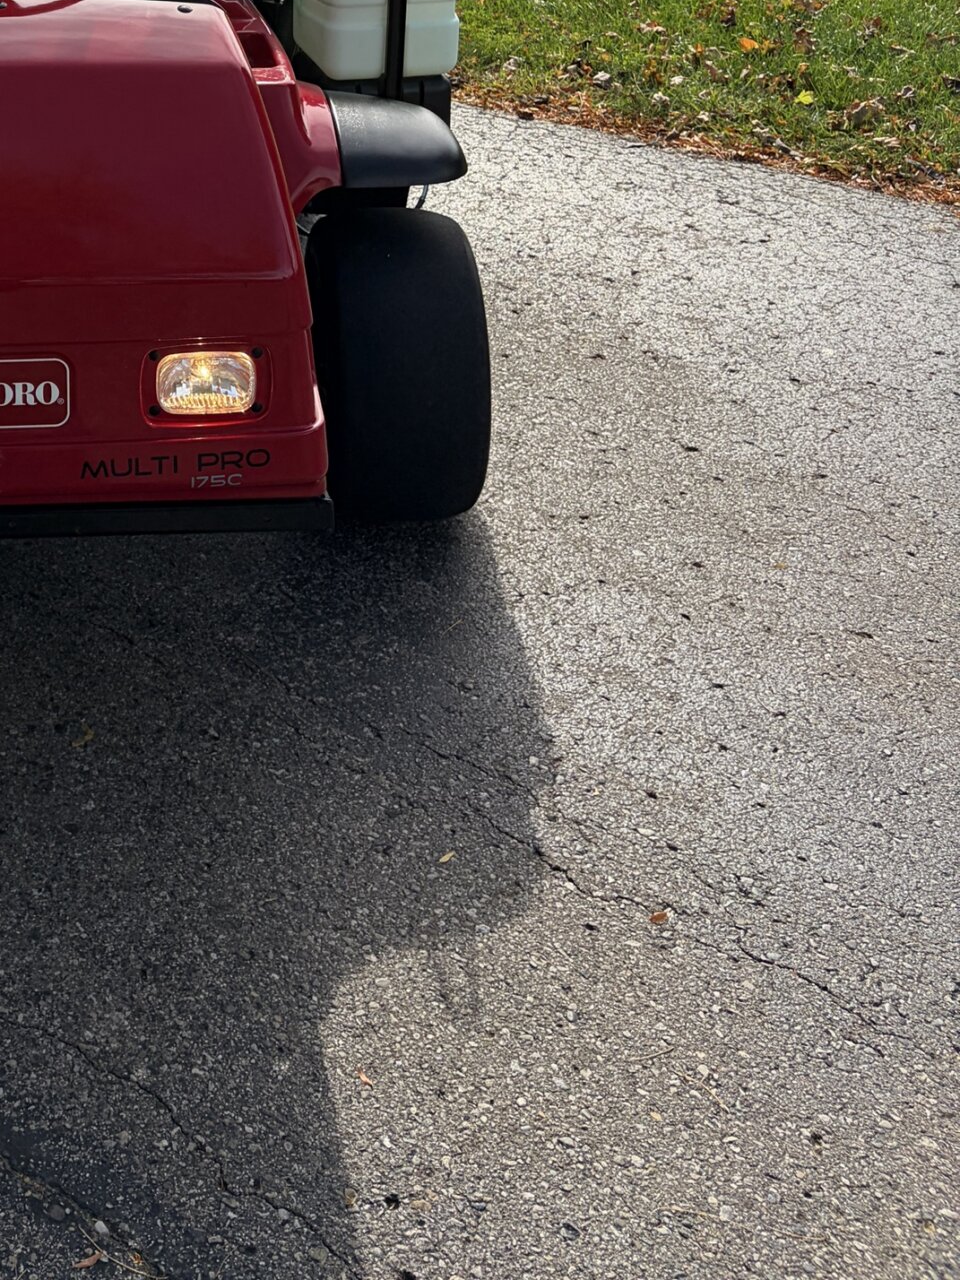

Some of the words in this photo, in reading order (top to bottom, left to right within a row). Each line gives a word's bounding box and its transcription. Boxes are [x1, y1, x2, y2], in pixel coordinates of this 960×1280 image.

[80, 455, 179, 480] MULTI
[197, 448, 271, 472] PRO
[190, 473, 243, 489] 175C
